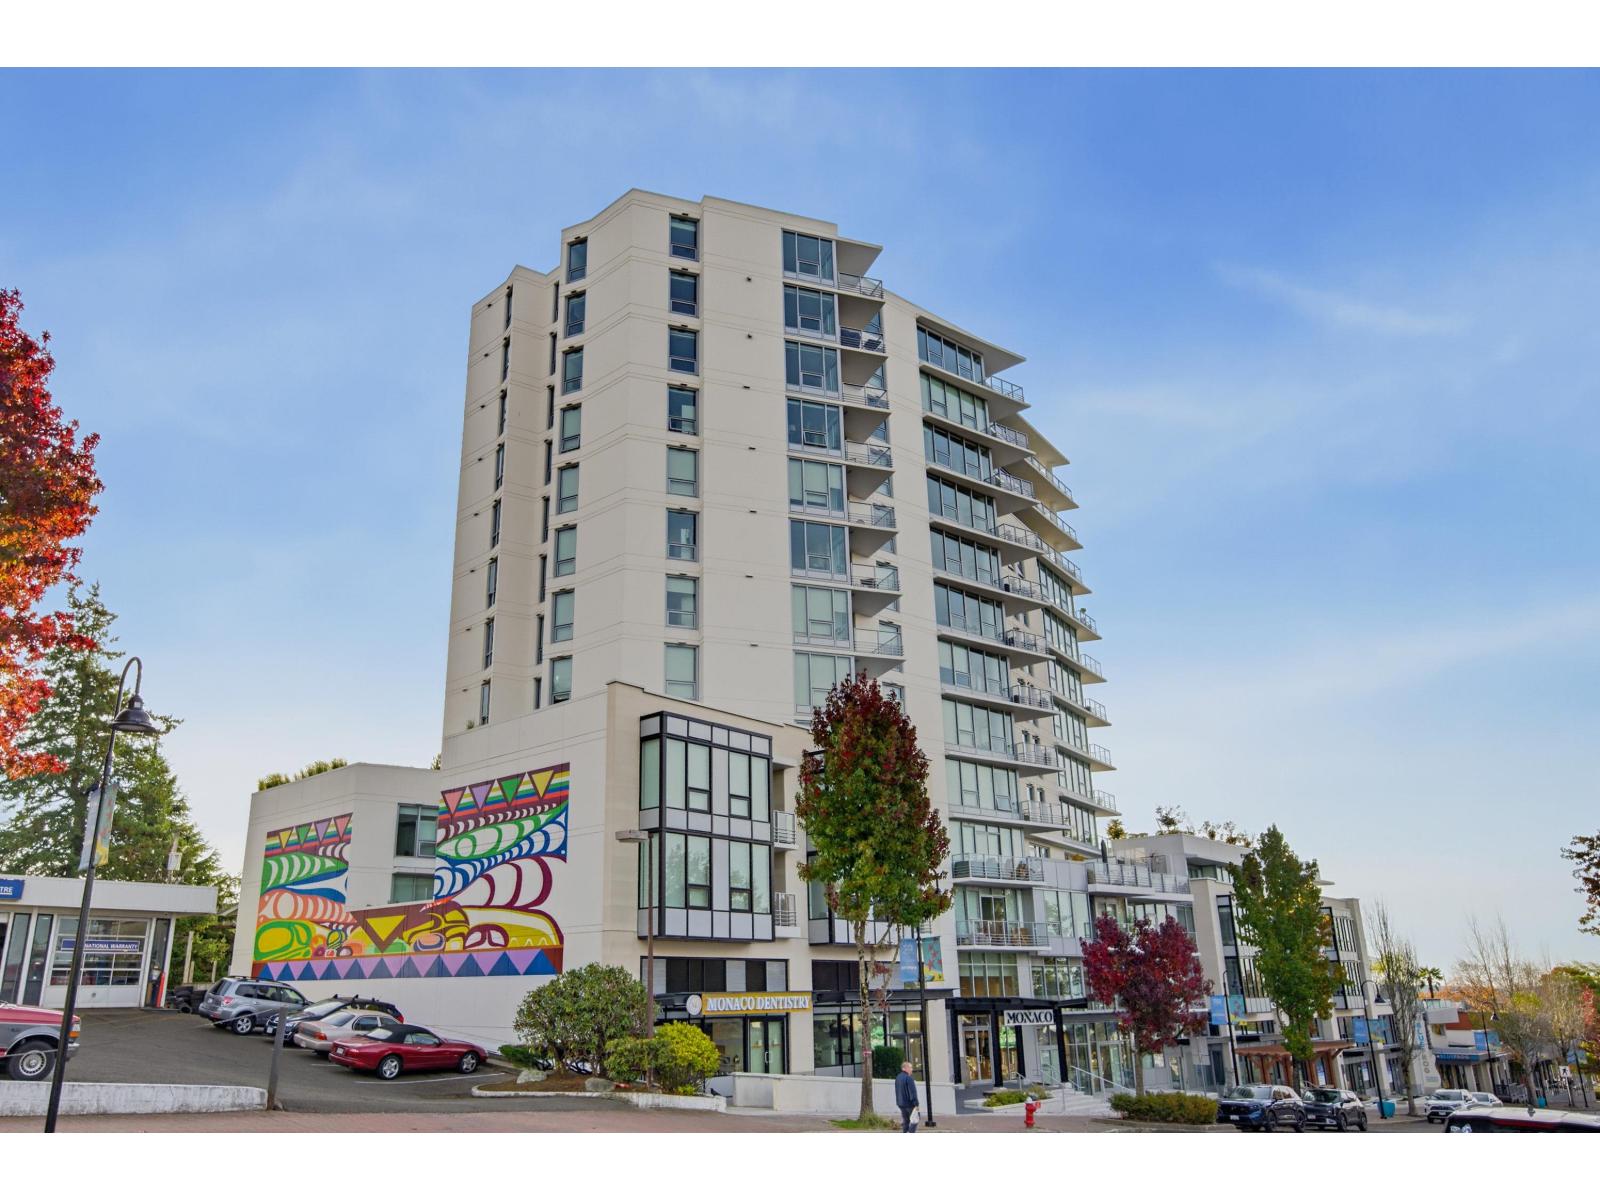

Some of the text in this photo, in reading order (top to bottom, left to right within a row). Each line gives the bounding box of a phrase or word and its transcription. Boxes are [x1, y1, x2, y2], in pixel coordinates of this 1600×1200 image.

[707, 996, 809, 1011] MONACO DENTISTRY
[1006, 1011, 1053, 1024] MONACO
